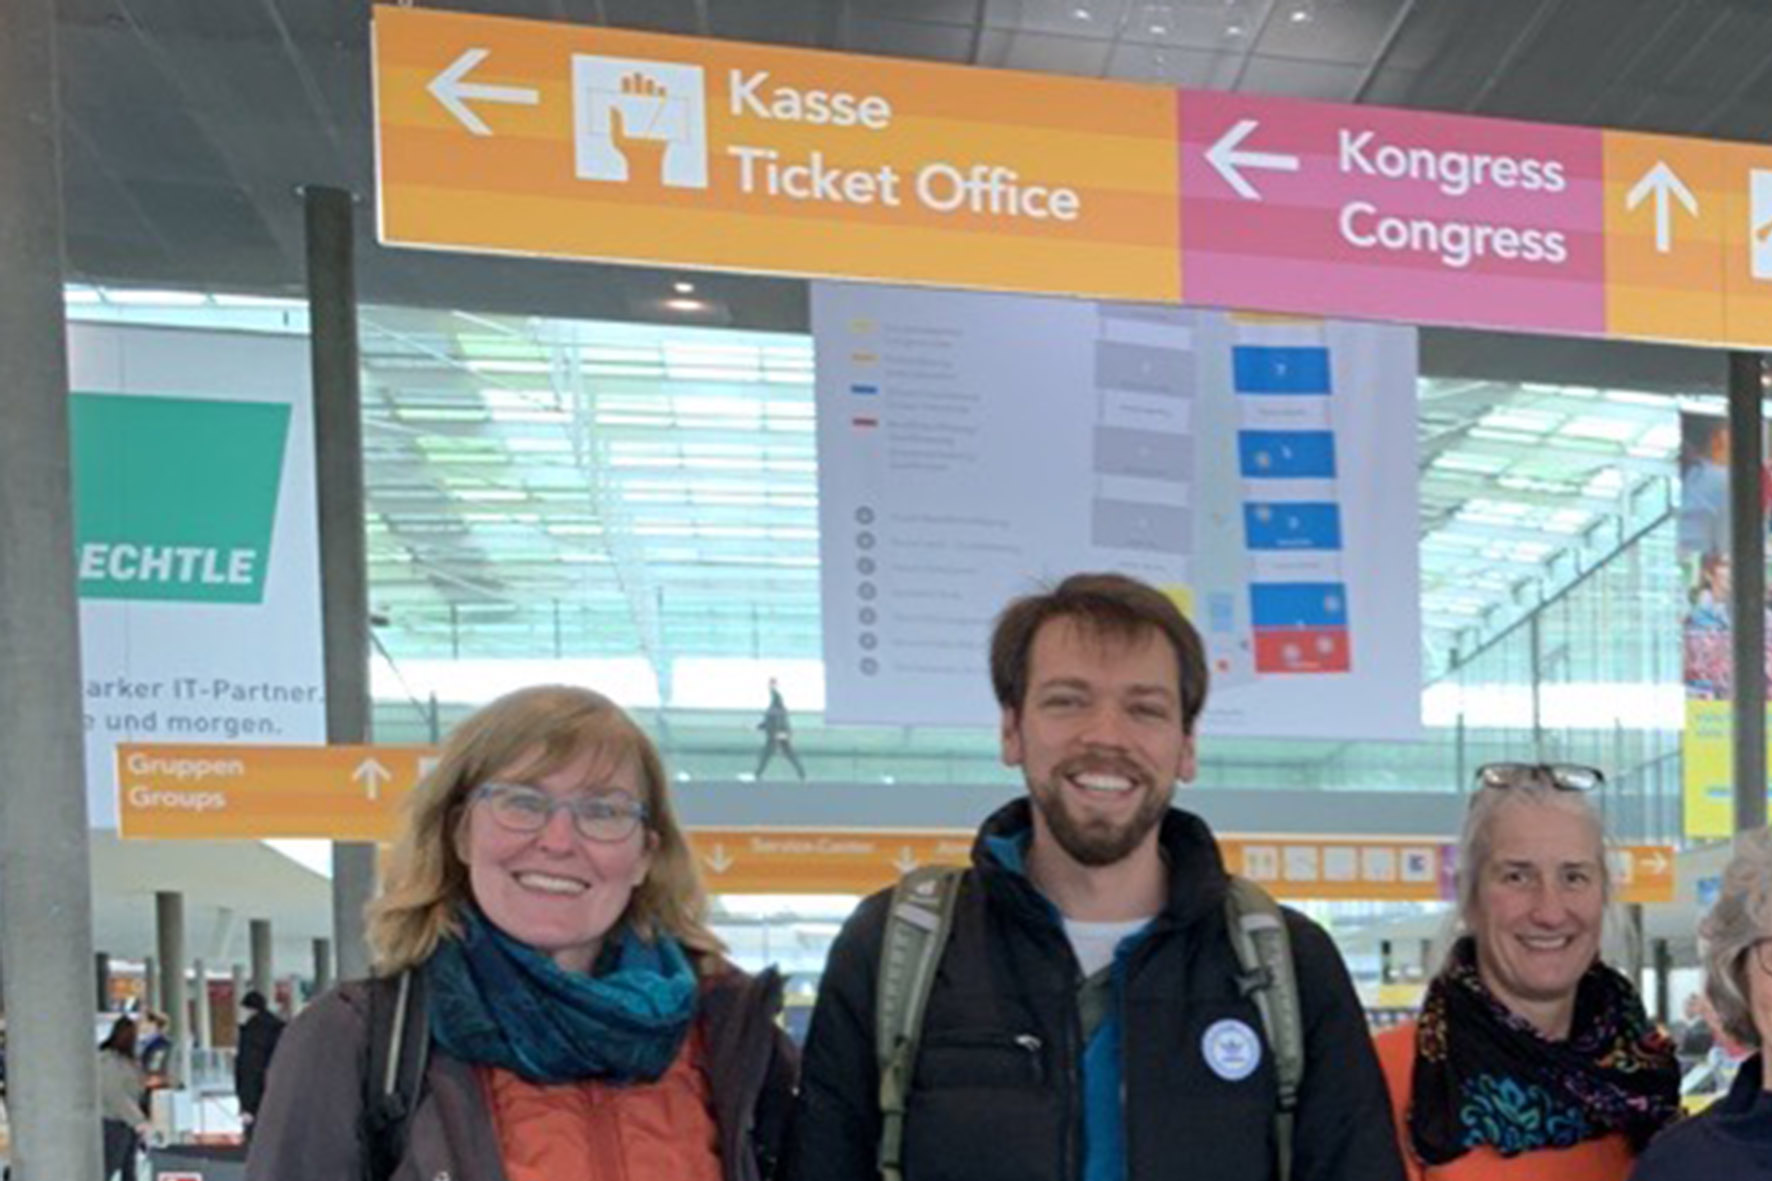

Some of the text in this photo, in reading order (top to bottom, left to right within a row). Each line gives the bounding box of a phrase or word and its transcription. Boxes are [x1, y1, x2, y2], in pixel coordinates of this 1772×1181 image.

[728, 68, 892, 130] Kasse
[727, 145, 1081, 222] Ticket Office
[1338, 129, 1567, 196] Kongress
[1339, 201, 1568, 267] Congress
[80, 542, 257, 584] ECHTLE
[86, 678, 163, 699] arker
[106, 712, 157, 732] und
[167, 715, 283, 739] morgen.
[127, 753, 245, 780] Gruppen
[129, 785, 226, 813] Groups
